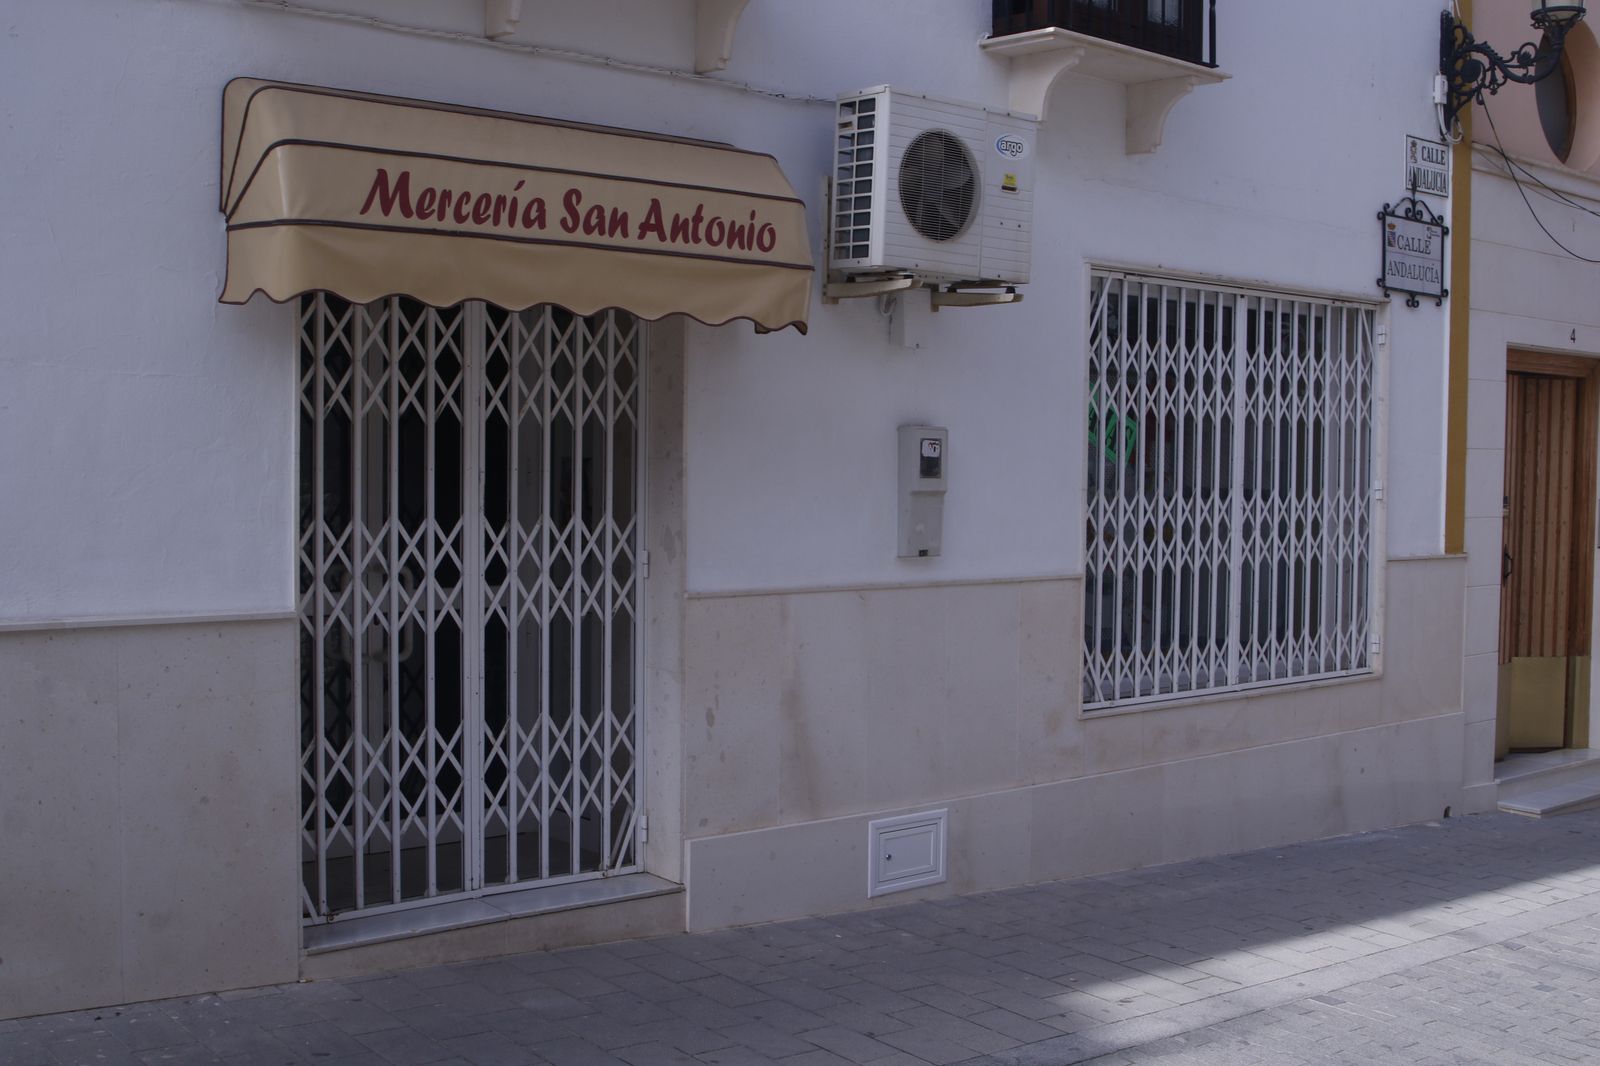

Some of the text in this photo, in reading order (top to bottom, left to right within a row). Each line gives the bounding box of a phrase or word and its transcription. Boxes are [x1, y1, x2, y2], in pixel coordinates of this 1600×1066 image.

[1000, 140, 1024, 156] argo
[1421, 145, 1446, 166] CALLE
[359, 168, 778, 253] Mercería San Antonio
[1396, 234, 1432, 255] CALLE
[1386, 260, 1441, 284] ANDALUCÍA
[1569, 327, 1576, 344] 4
